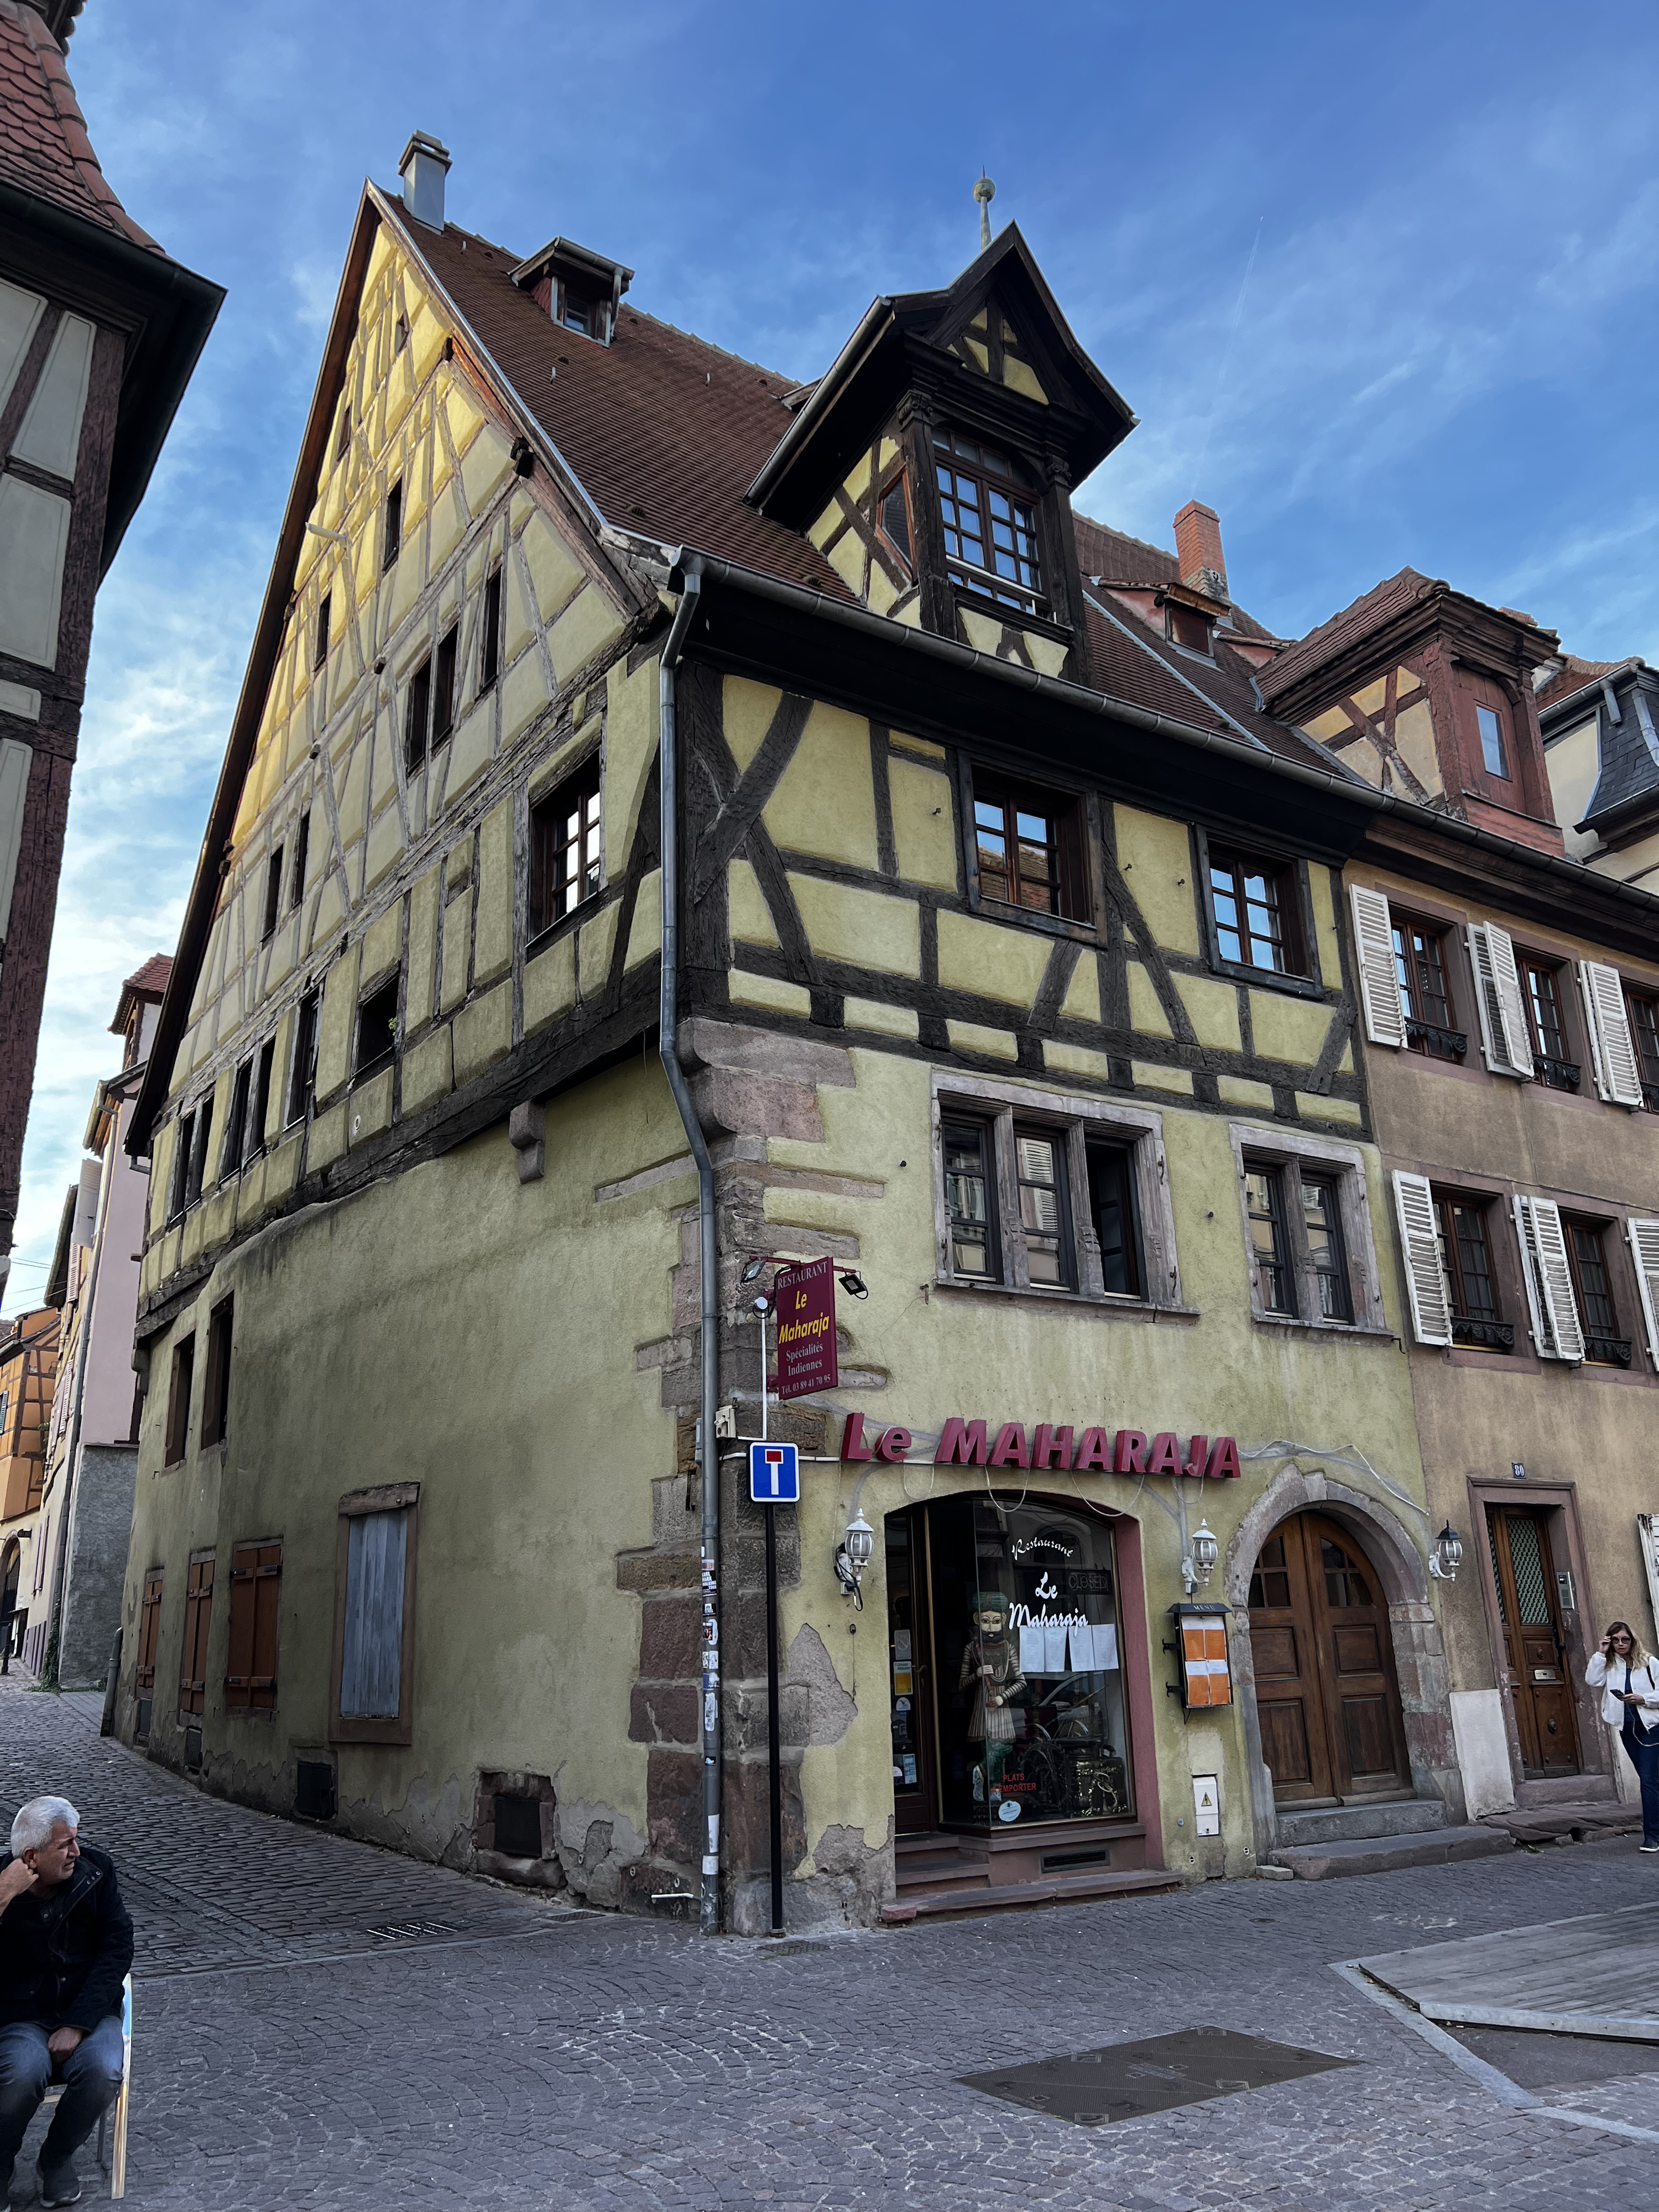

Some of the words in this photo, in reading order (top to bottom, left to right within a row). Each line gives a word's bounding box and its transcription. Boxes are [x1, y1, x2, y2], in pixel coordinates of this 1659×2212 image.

[778, 1261, 828, 1289] RESTAURANT
[795, 1290, 807, 1310] Le
[779, 1312, 830, 1344] Maharaja
[786, 1341, 823, 1363] Spécialités
[788, 1359, 822, 1376] Indiennes
[792, 1383, 799, 1391] 03
[800, 1380, 807, 1390] 89
[808, 1378, 814, 1387] 41
[816, 1376, 822, 1385] 70
[823, 1374, 831, 1383] 95
[841, 1412, 912, 1462] Le
[935, 1417, 1241, 1478] MAHARAJA
[1515, 1465, 1524, 1476] 80
[1011, 1537, 1073, 1561] Restaurant
[1035, 1572, 1058, 1599] Le
[1009, 1603, 1088, 1637] Maharaja
[998, 1783, 1036, 1792] EMPORTER
[1003, 1773, 1024, 1782] PLATS
